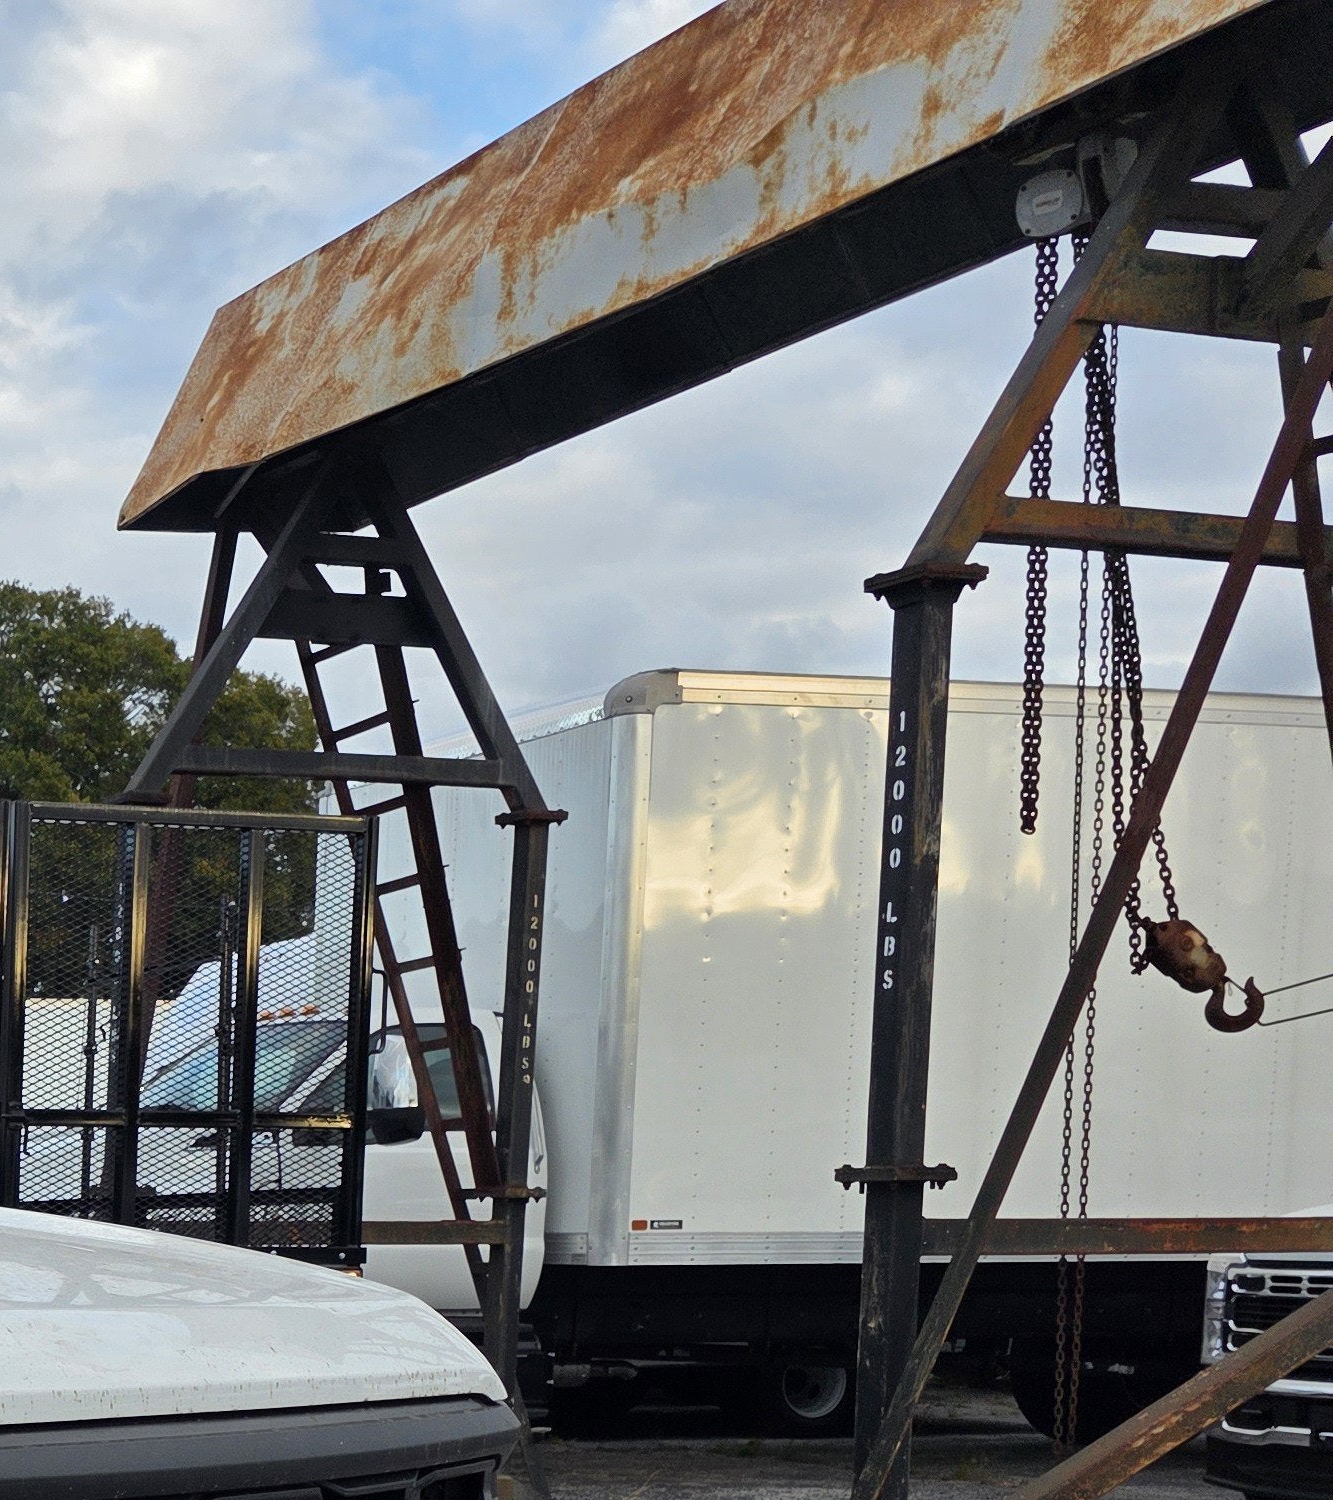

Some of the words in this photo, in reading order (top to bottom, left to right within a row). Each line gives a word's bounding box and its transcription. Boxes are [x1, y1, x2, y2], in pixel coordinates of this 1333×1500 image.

[889, 711, 906, 868] 12000
[525, 894, 539, 994] 12000
[882, 902, 898, 989] LBS
